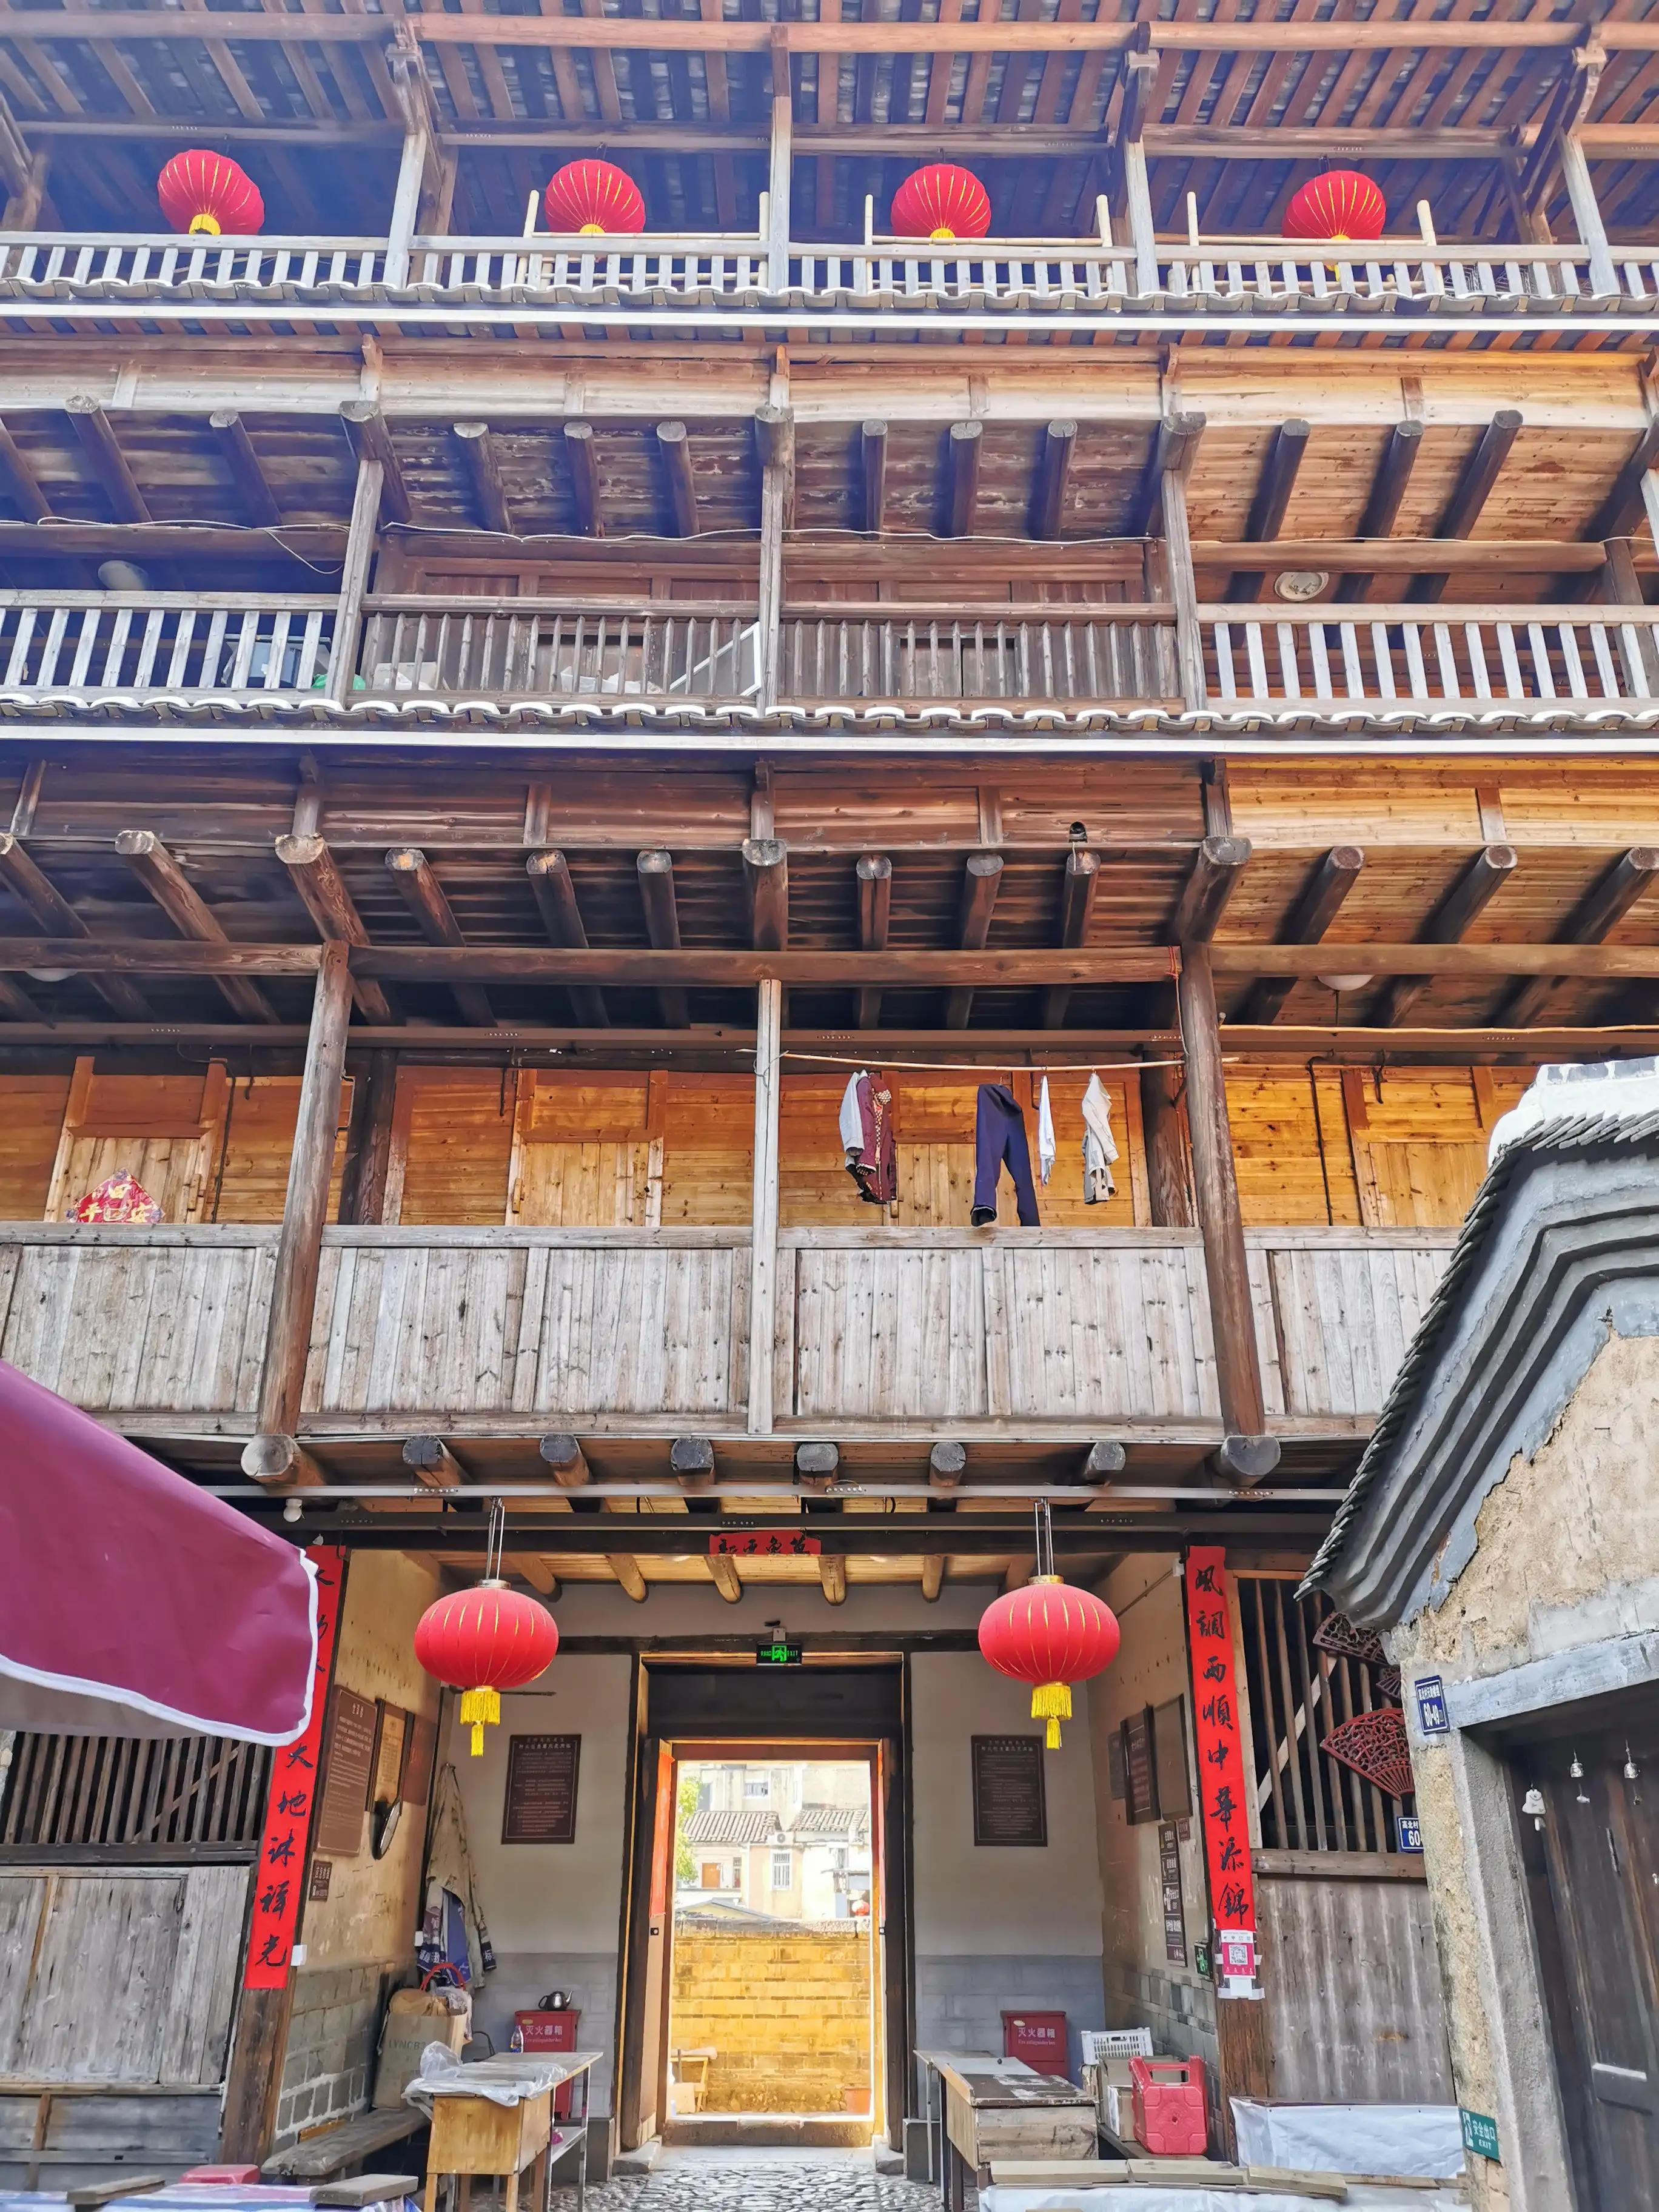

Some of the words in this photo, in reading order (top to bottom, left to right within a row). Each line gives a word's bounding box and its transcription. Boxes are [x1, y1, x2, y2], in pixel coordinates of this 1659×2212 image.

[526, 2025, 563, 2036] 灭火器箱
[1018, 2027, 1055, 2038] 灭火器箱
[1472, 2119, 1496, 2141] 安全出口
[1478, 2139, 1492, 2150] EXIT
